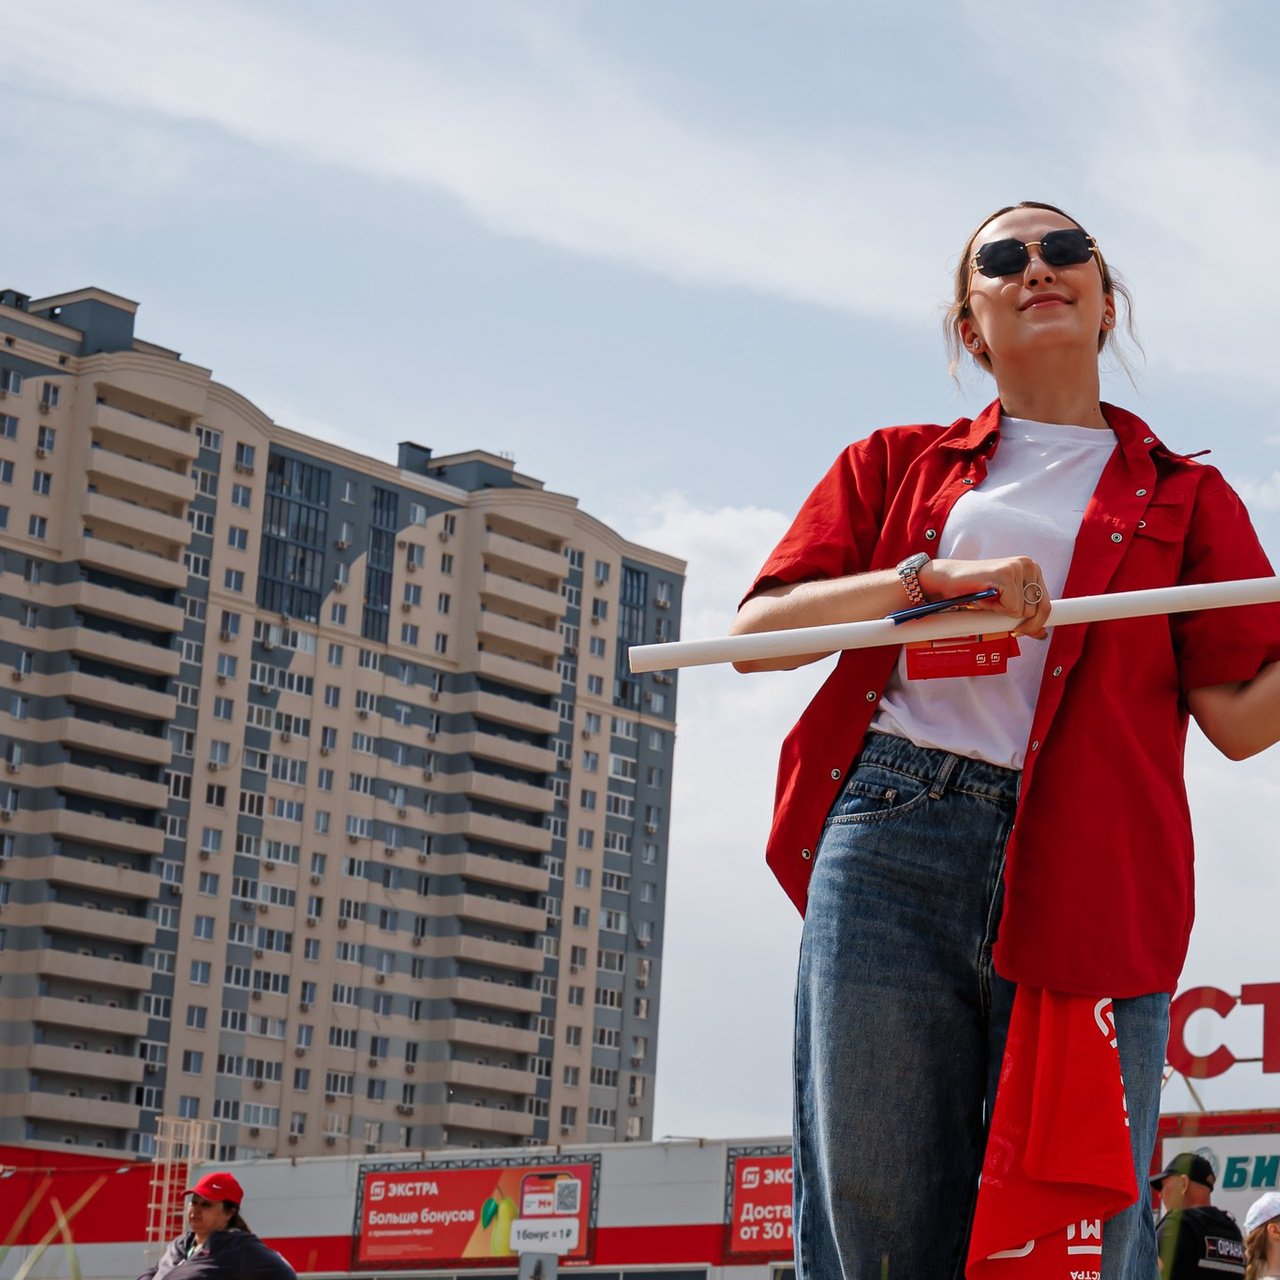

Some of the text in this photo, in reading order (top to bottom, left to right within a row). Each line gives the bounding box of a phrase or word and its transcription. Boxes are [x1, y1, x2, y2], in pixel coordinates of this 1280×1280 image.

[388, 1182, 439, 1198] ЭКСТРА
[368, 1208, 475, 1226] Больше бонусов
[740, 1202, 793, 1223] Доста
[740, 1225, 760, 1240] от
[763, 1222, 784, 1239] 30
